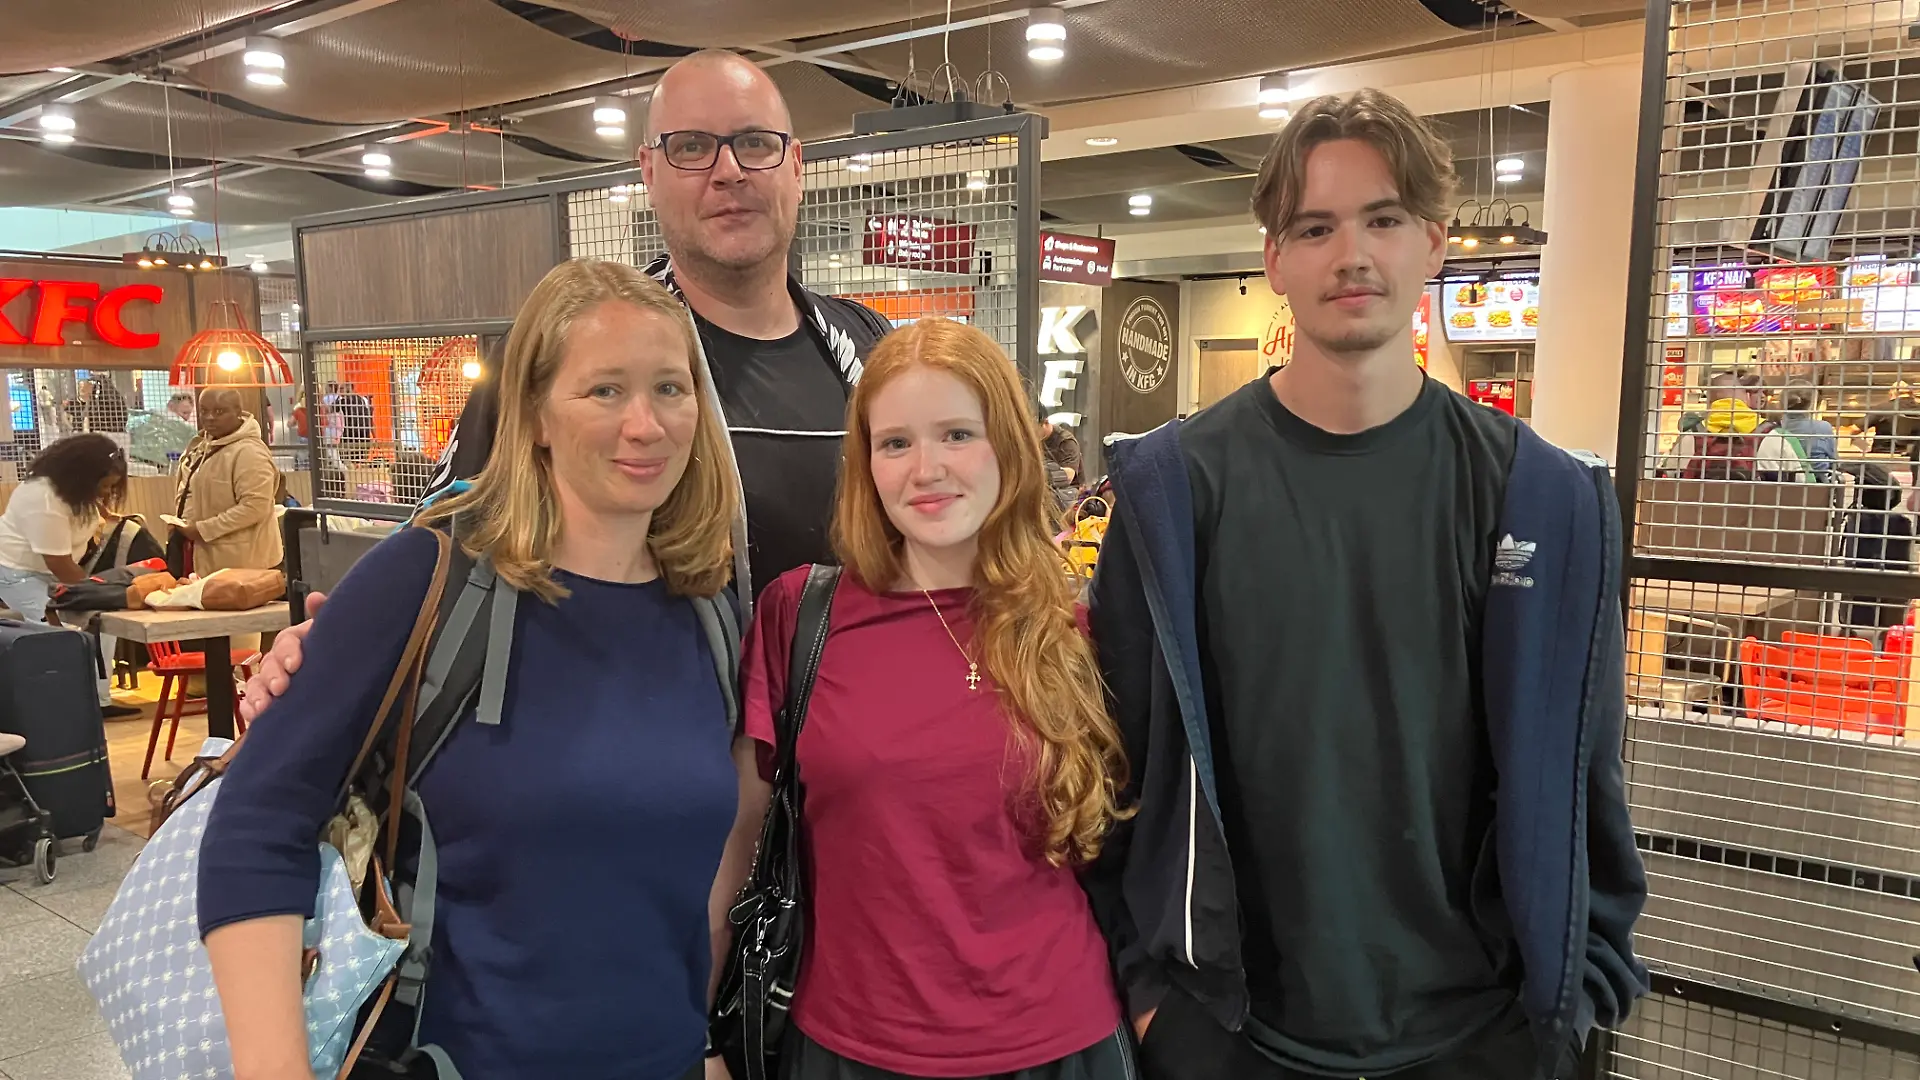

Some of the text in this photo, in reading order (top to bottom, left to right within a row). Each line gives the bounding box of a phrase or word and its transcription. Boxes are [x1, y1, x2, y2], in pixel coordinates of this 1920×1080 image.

[1122, 327, 1169, 361] HANDMADE
[1126, 365, 1156, 389] IN KFC
